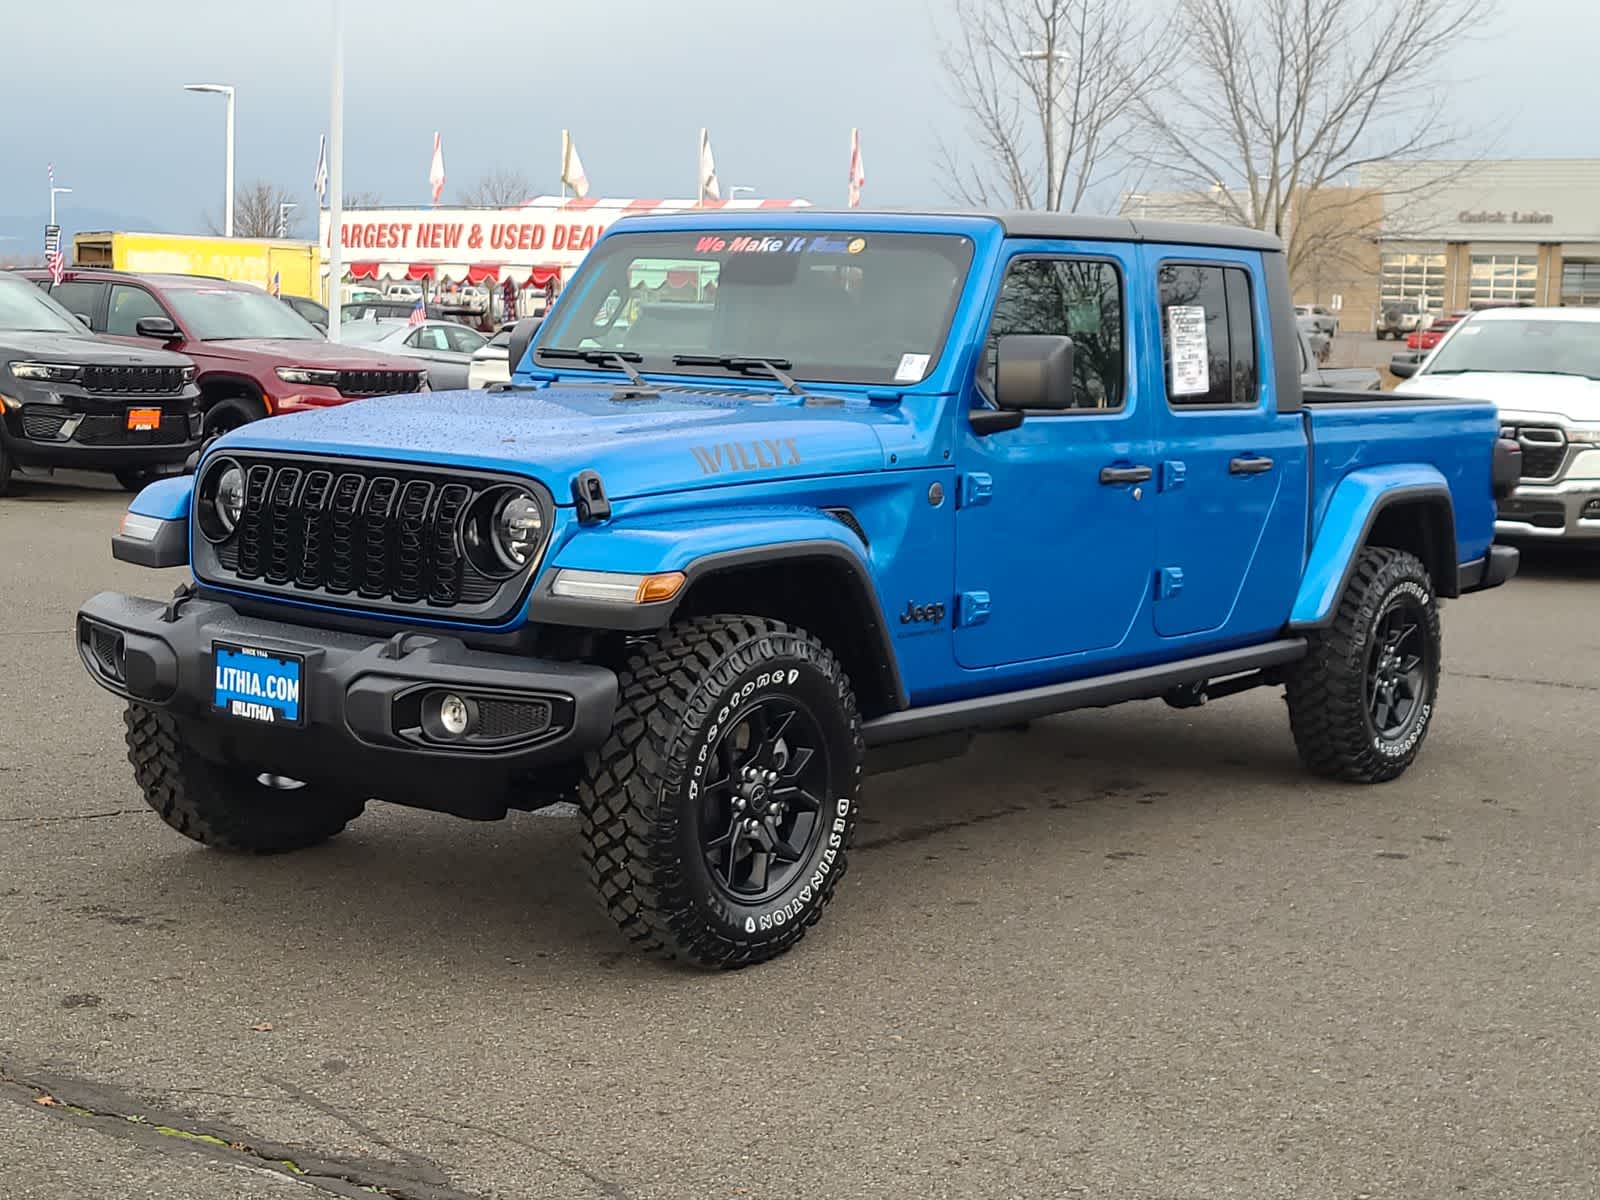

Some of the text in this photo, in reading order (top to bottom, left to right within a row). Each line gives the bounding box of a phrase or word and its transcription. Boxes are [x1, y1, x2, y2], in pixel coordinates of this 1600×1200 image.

[328, 223, 412, 249] ARGEST
[416, 223, 463, 249] NEW
[467, 223, 483, 249] &
[489, 223, 546, 250] USED
[695, 236, 726, 253] We
[728, 235, 784, 253] Make
[786, 236, 807, 252] It
[688, 437, 801, 475] WILLYS
[900, 599, 945, 625] Jeep
[216, 666, 299, 703] LITHIA.COM
[241, 701, 275, 722] LITHIA
[759, 798, 849, 931] DESTINATION
